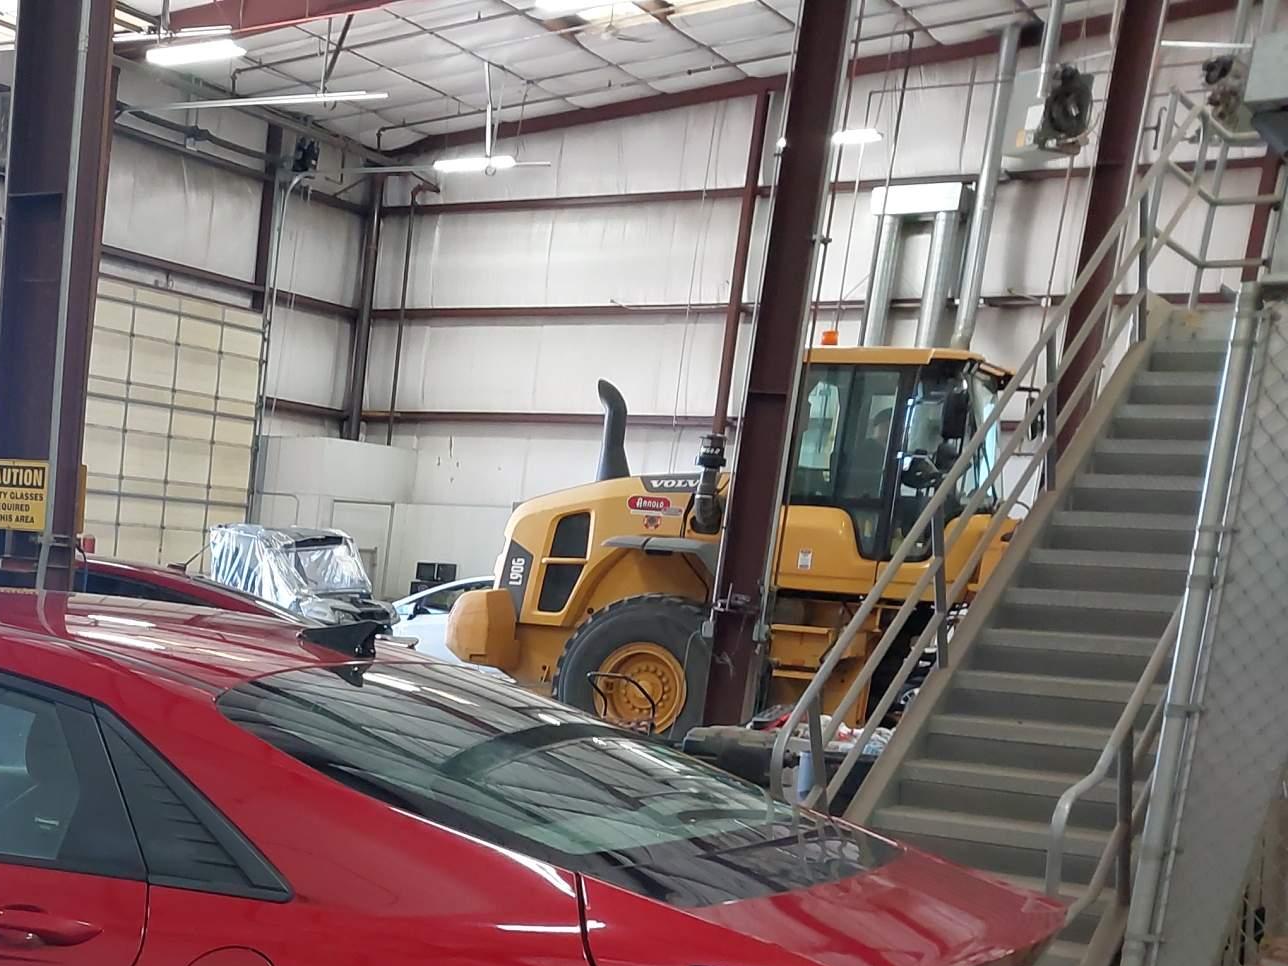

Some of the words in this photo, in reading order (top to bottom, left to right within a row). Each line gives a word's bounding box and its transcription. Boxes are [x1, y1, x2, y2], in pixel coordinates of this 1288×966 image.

[650, 479, 700, 488] VOLV
[9, 491, 44, 502] GLASSES
[14, 514, 35, 524] AREA
[508, 557, 526, 586] L90G
